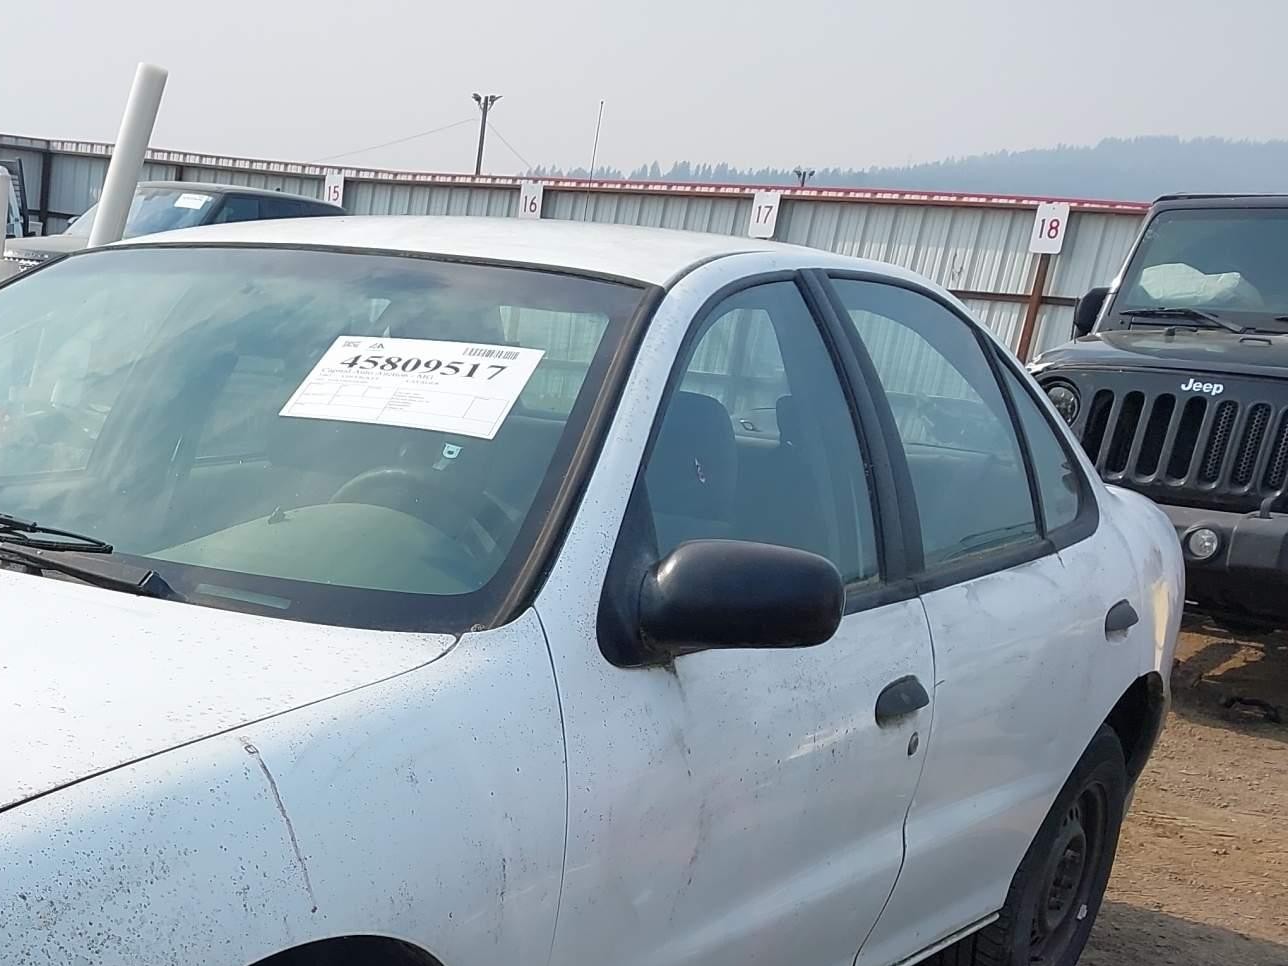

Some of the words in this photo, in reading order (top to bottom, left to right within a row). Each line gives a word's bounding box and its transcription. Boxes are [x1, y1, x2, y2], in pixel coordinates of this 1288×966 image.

[327, 185, 340, 202] 15
[523, 196, 538, 213] 16
[755, 205, 773, 224] 17
[1038, 218, 1060, 239] 18
[340, 354, 509, 380] 45809517
[1181, 378, 1224, 396] Jeep
